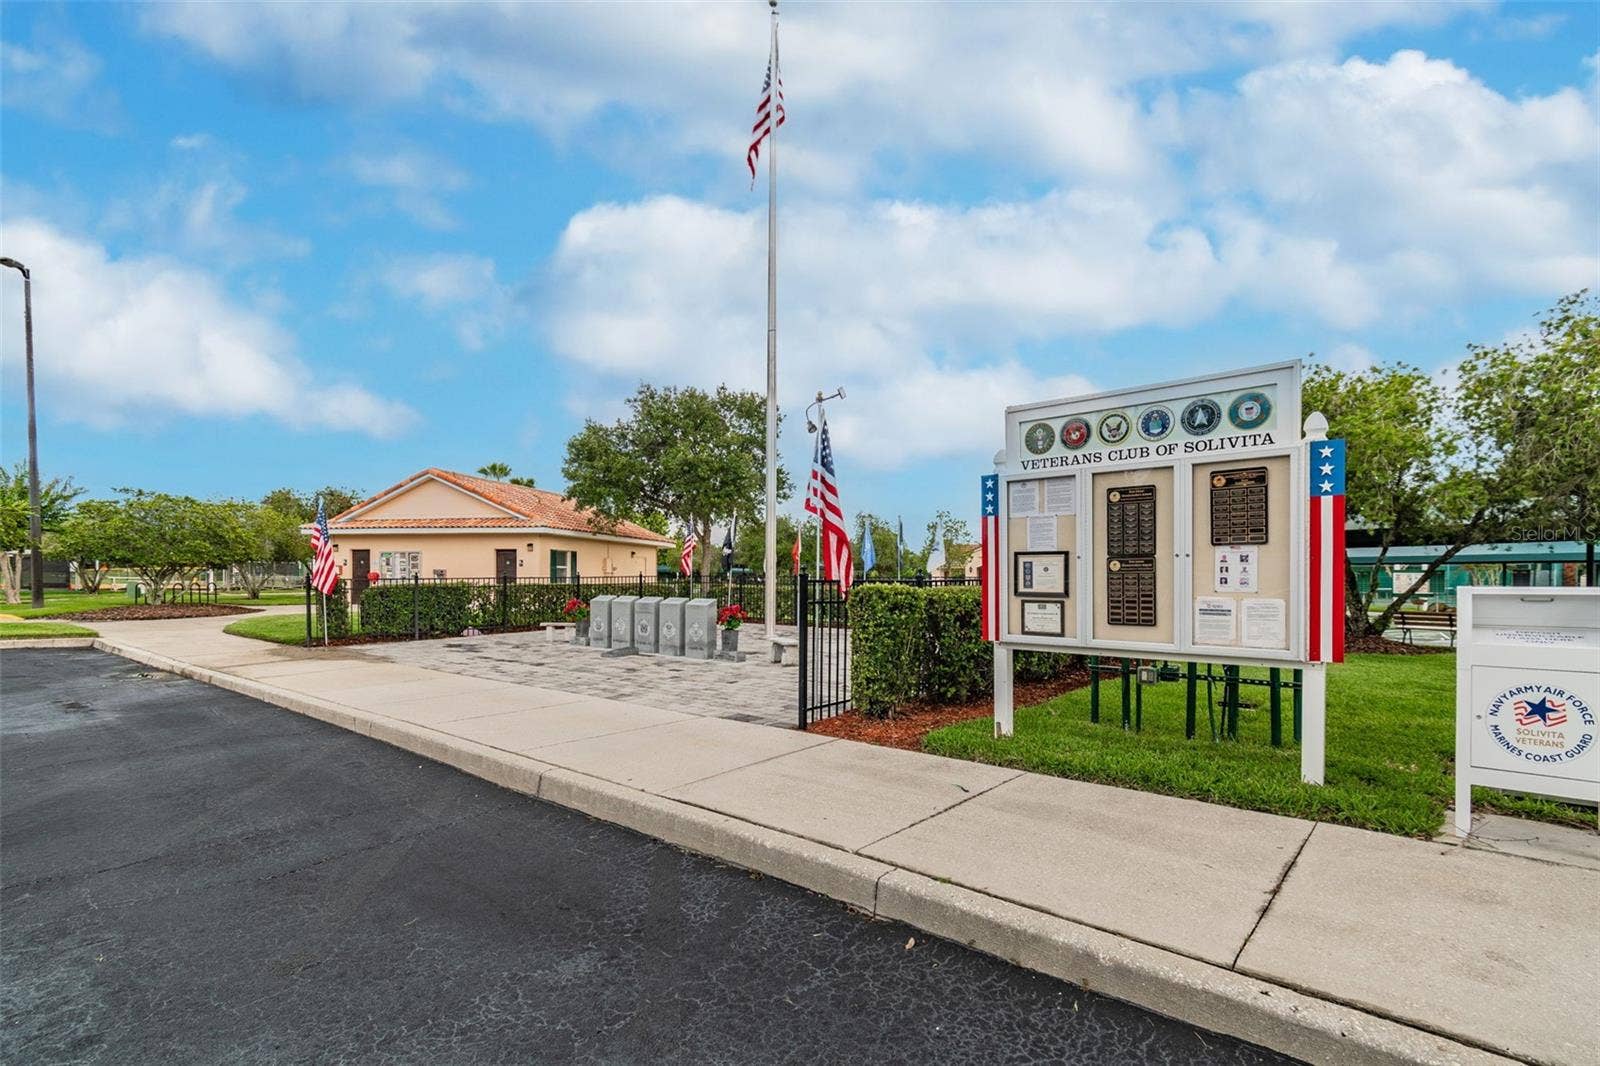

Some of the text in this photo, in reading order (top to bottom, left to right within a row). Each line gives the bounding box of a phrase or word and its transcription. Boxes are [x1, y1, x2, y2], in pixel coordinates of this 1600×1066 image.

[1021, 432, 1275, 470] VETERANS CLUB OF SOLIVITA
[1489, 685, 1595, 726] NAVY ARMY AIR FORCE
[1490, 724, 1593, 763] MARINES COAST GUARD
[1515, 737, 1565, 749] VETERANS
[1516, 727, 1565, 740] SOLIVITA
